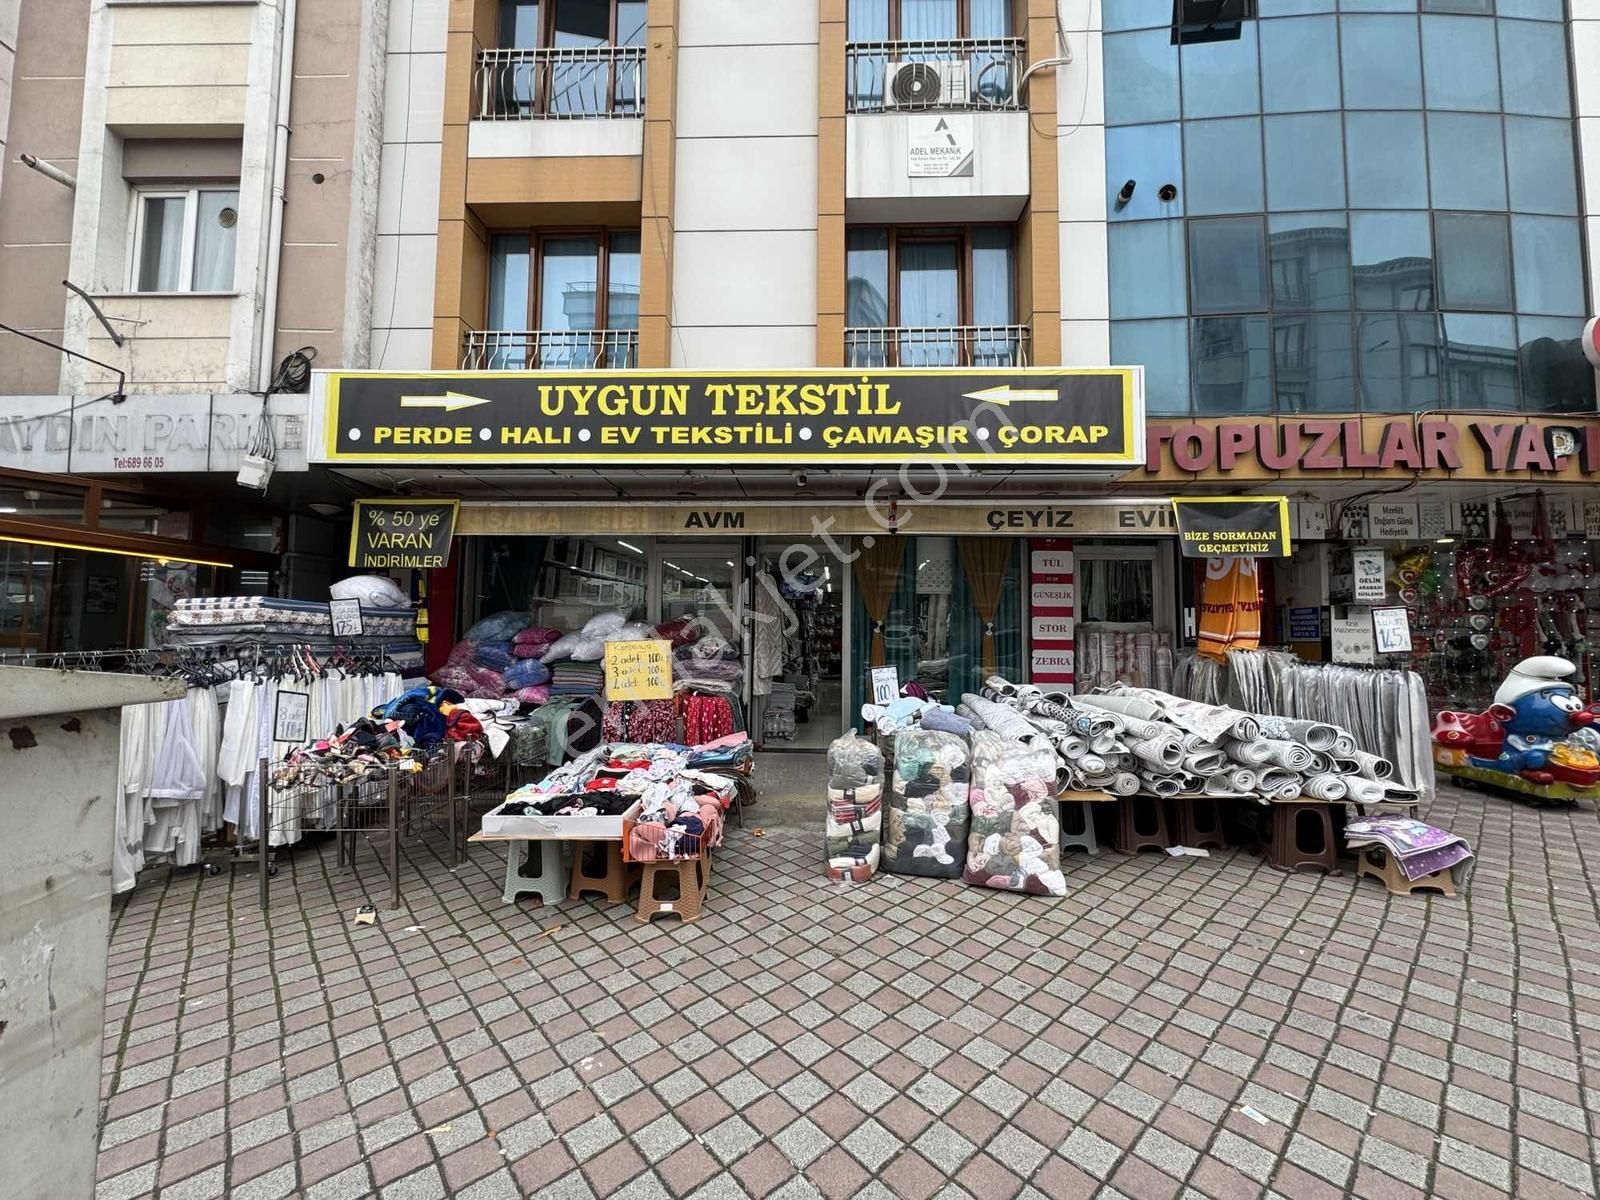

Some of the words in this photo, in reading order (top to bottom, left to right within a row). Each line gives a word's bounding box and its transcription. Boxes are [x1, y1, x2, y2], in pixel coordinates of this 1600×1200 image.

[910, 147, 928, 155] ADEL
[538, 384, 690, 416] UYGUN
[705, 375, 902, 416] TEKSTİL
[373, 426, 473, 445] PERDE
[500, 426, 572, 445] HALI
[600, 426, 642, 444] EV
[650, 422, 793, 445] TEKSTİLİ
[822, 425, 969, 449] ÇAMAŞIR
[997, 425, 1109, 449] ÇORAP
[1146, 423, 1463, 474] TOPUZLAR
[1469, 423, 1600, 473] YAPI
[143, 457, 152, 468] 66
[154, 457, 164, 468] 05
[368, 511, 385, 527] %
[391, 511, 414, 527] 50
[418, 513, 440, 530] ye
[684, 511, 745, 529] AVM
[986, 507, 1074, 531] ÇEYİZ
[367, 532, 433, 549] VARAN
[1183, 530, 1210, 541] BİZE
[1212, 531, 1277, 541] SORMADAN
[1198, 542, 1269, 555] GEÇMEYİNİZ
[364, 553, 443, 568] İNDİRİMLER
[1042, 557, 1064, 568] TÜL
[1033, 590, 1072, 601] GÜNEŞLİK
[1039, 624, 1067, 632] STOR
[611, 655, 618, 666] 2
[620, 653, 640, 664] adet
[1035, 657, 1071, 666] ZEBRA
[611, 666, 619, 677] 3
